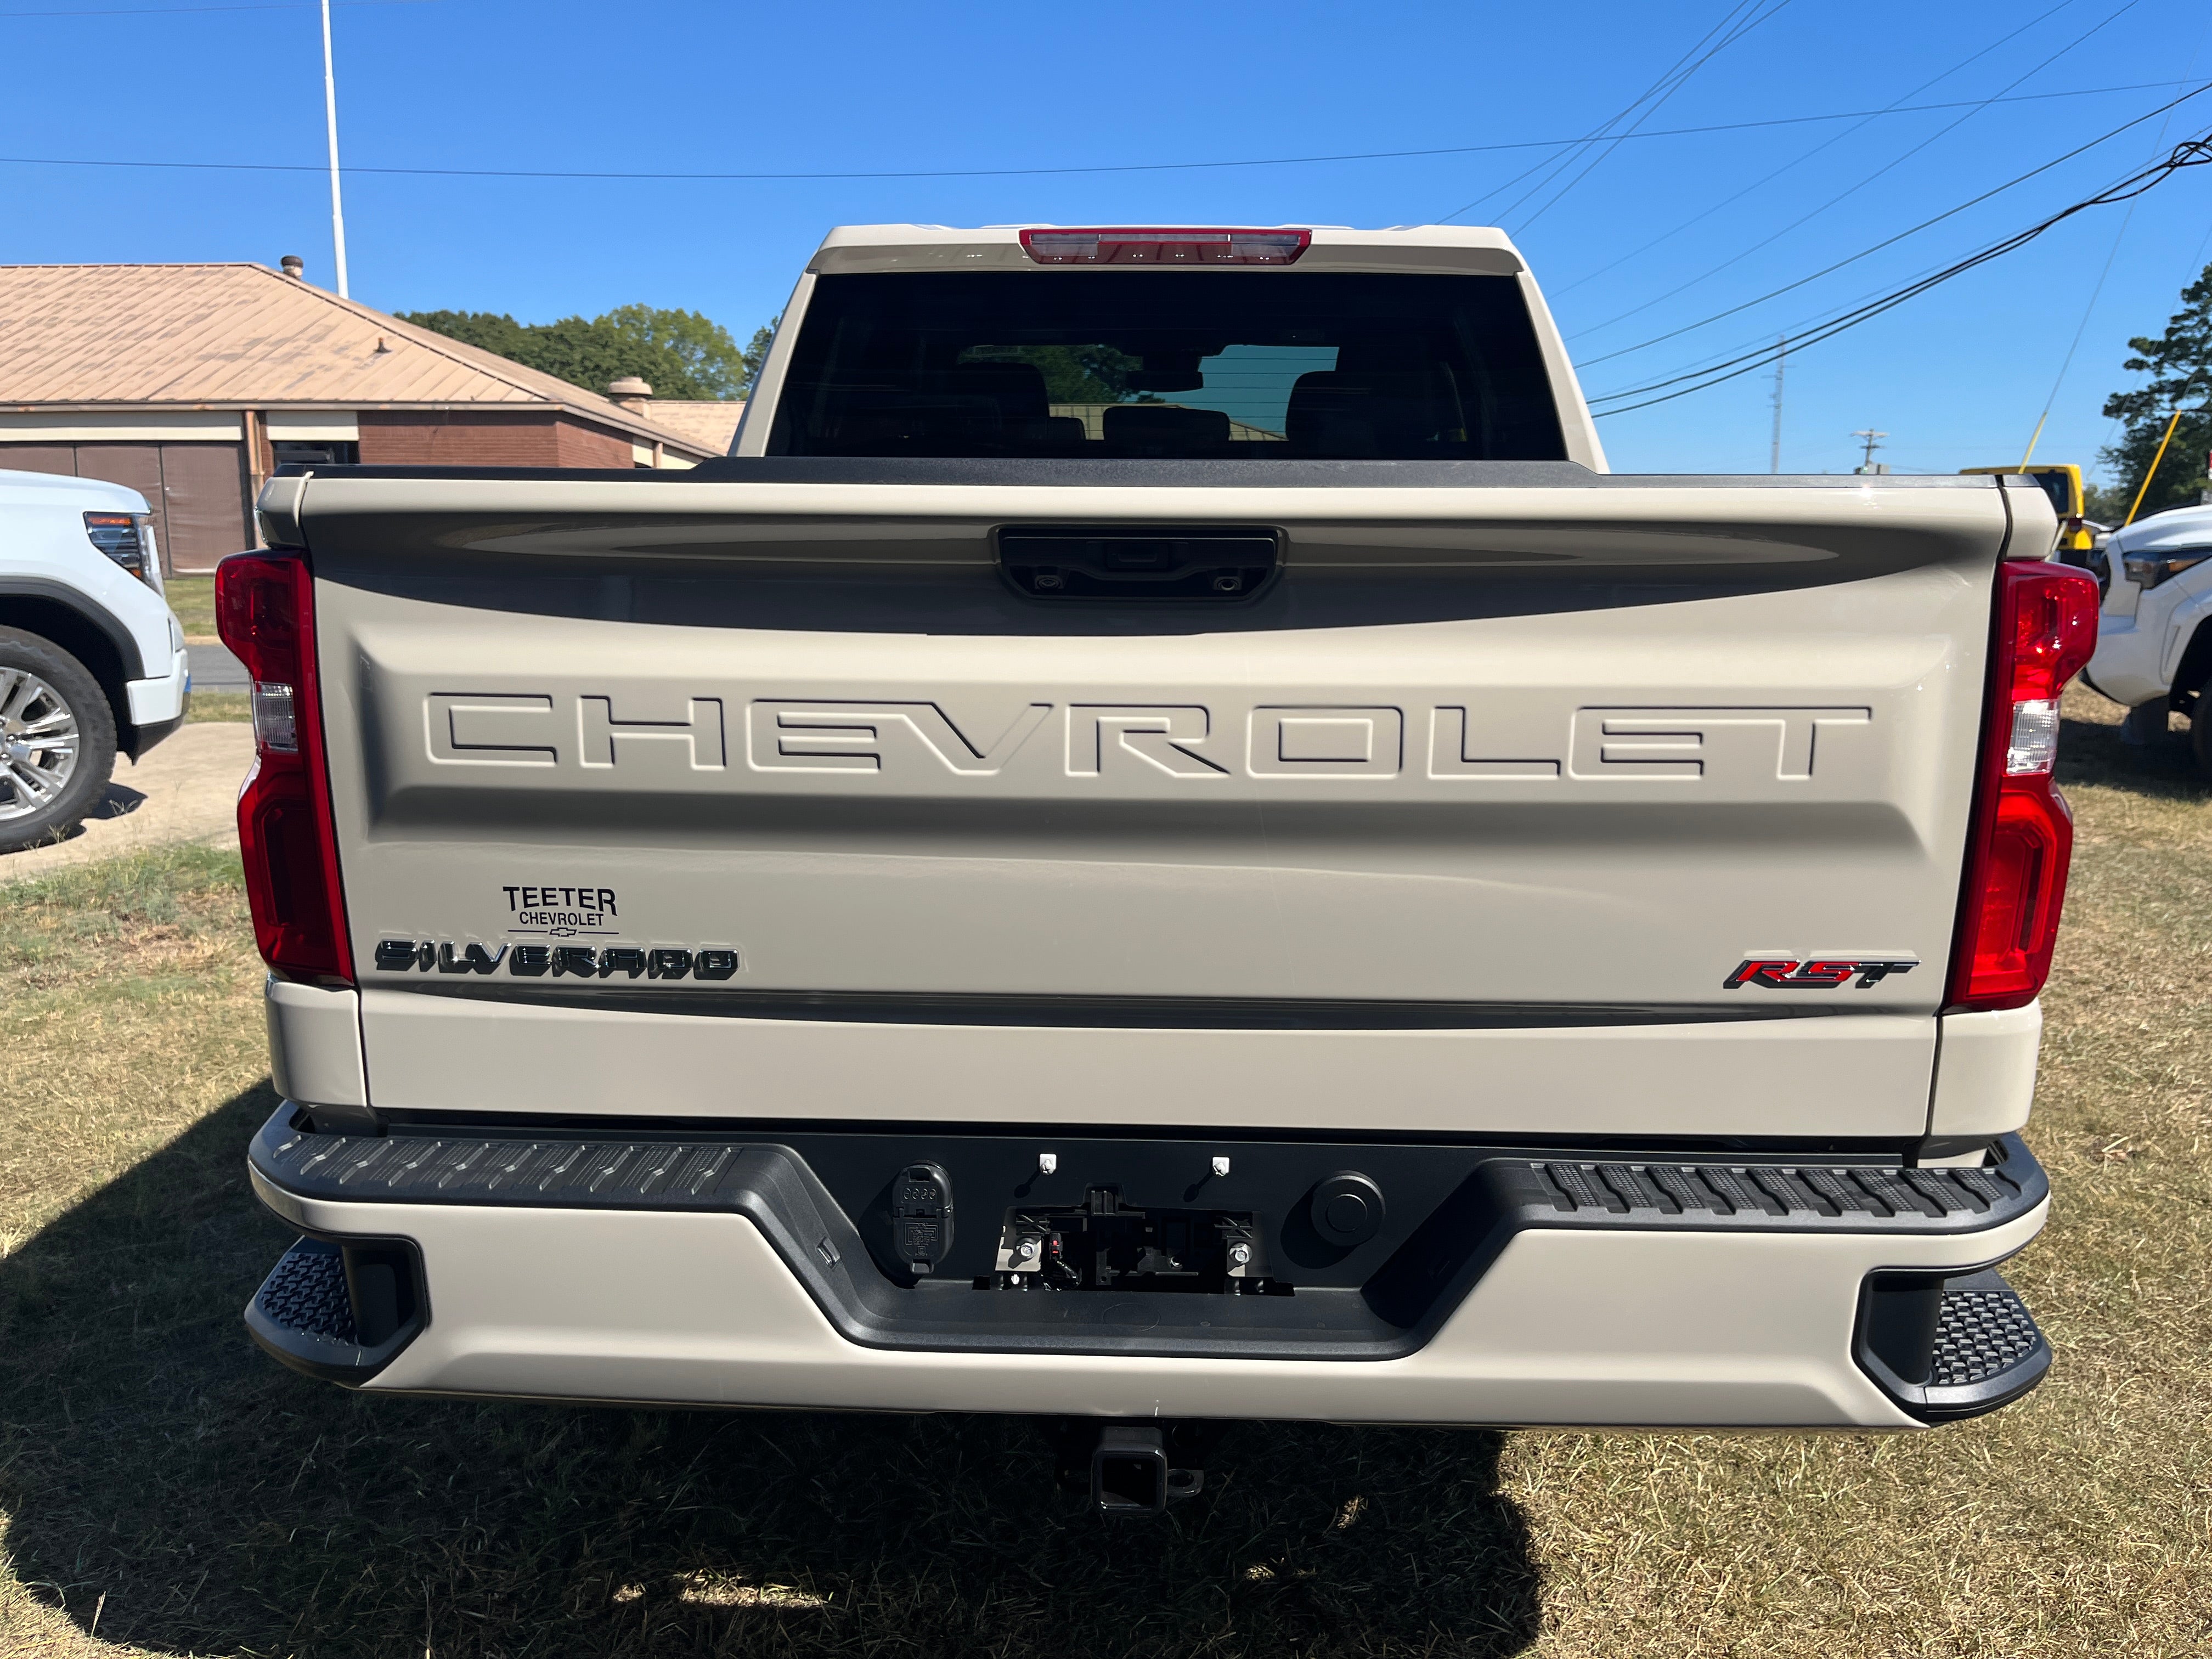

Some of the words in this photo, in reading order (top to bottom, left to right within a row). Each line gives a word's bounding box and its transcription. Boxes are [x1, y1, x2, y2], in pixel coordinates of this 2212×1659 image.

[422, 692, 1872, 781] CHEVROLET
[502, 885, 618, 917] TEETER
[519, 911, 604, 927] CHEVROLET
[376, 938, 741, 980] SILVERADO
[1724, 959, 1921, 989] RST
